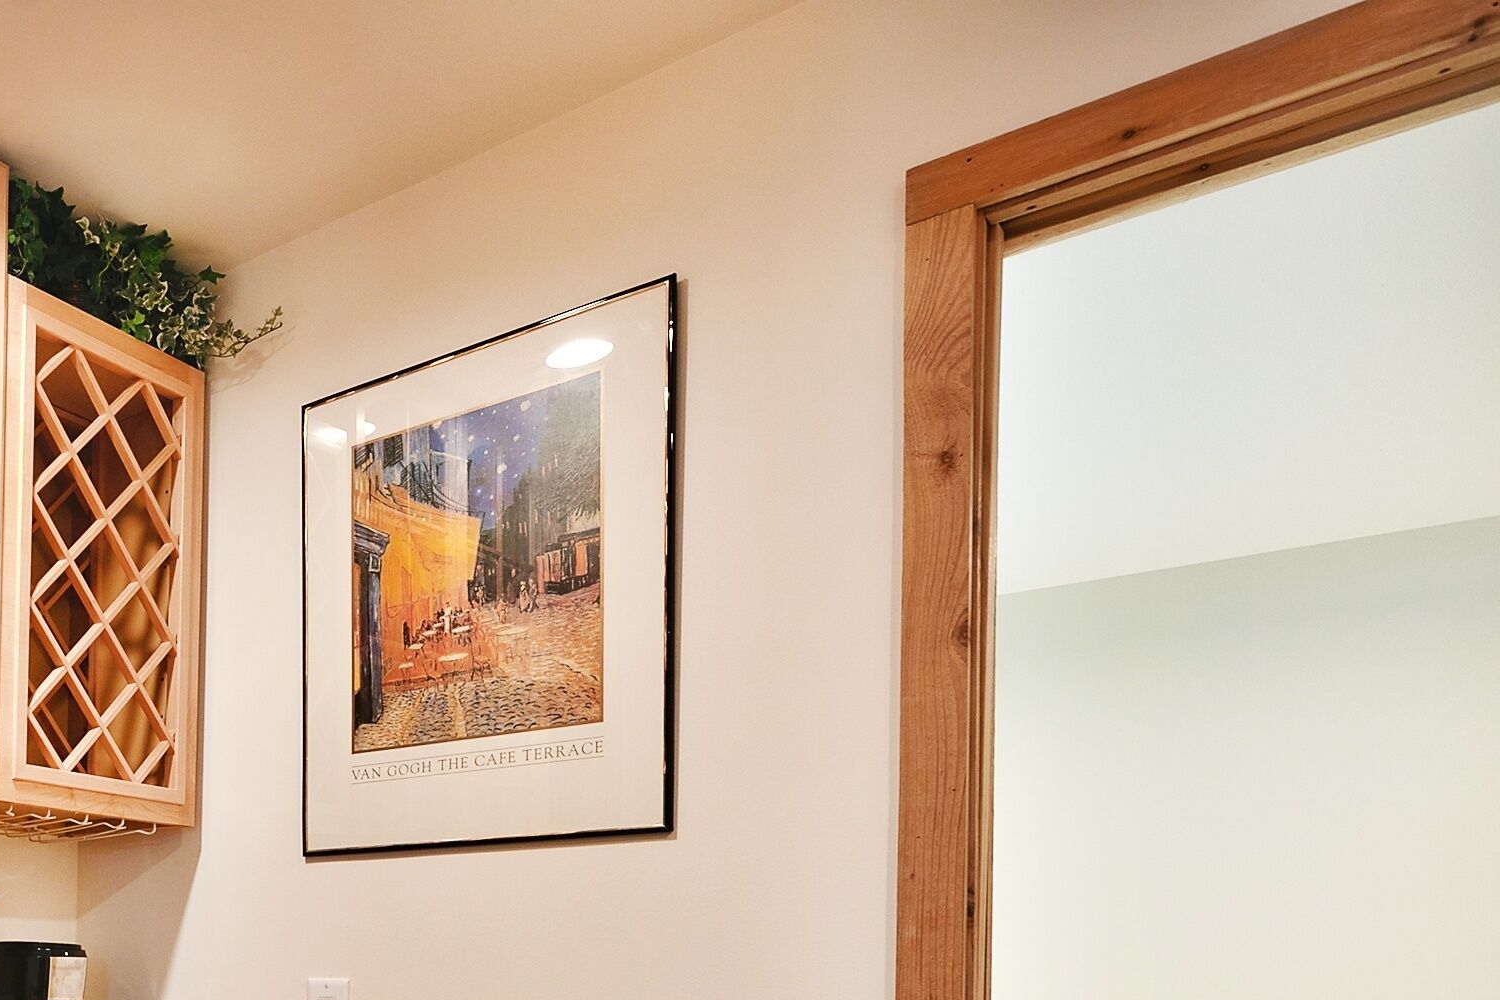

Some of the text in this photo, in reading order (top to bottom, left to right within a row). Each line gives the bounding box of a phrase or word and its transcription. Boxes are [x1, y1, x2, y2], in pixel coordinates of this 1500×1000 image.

[352, 740, 604, 780] VAN GOGH THE CAFE TERRACE
